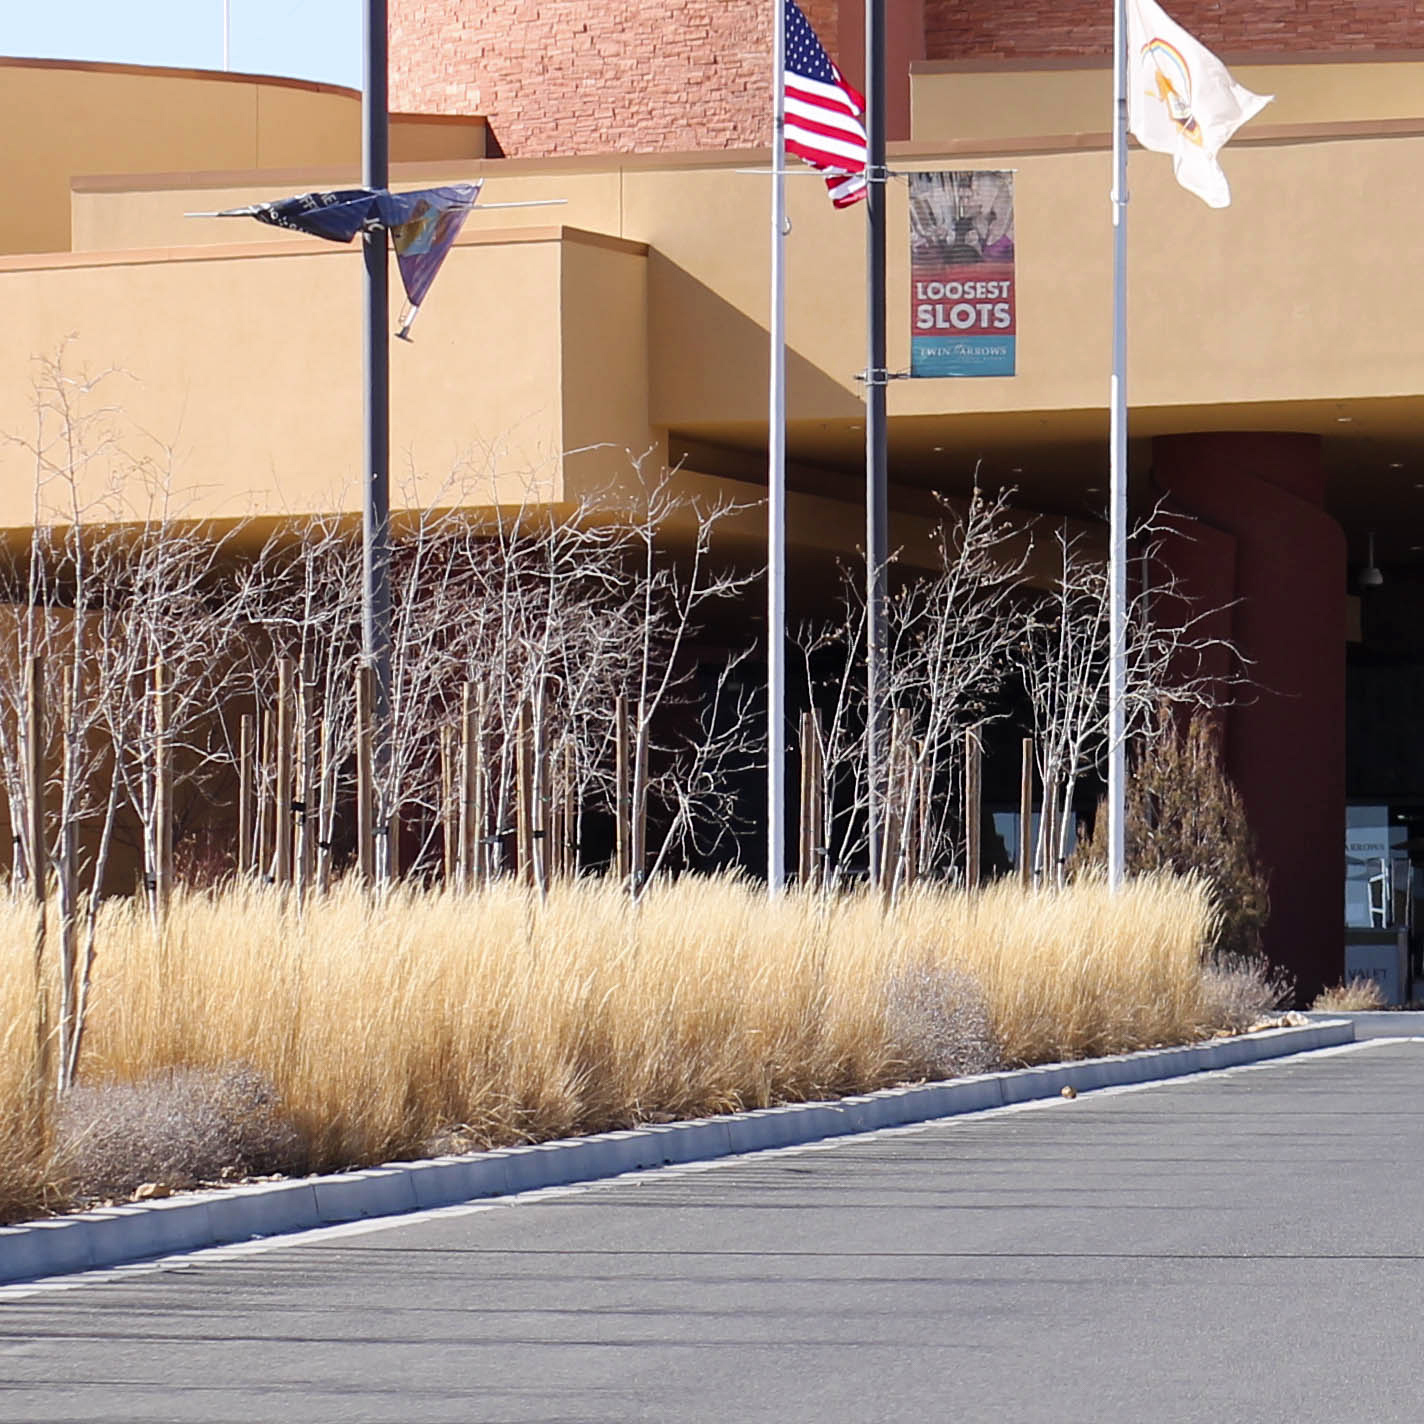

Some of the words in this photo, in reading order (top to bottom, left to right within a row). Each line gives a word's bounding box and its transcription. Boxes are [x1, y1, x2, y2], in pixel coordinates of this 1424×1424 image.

[916, 281, 1011, 299] LOOSEST
[916, 303, 1011, 329] SLOTS
[920, 347, 951, 356] TWIN
[959, 345, 1007, 356] ARROWS
